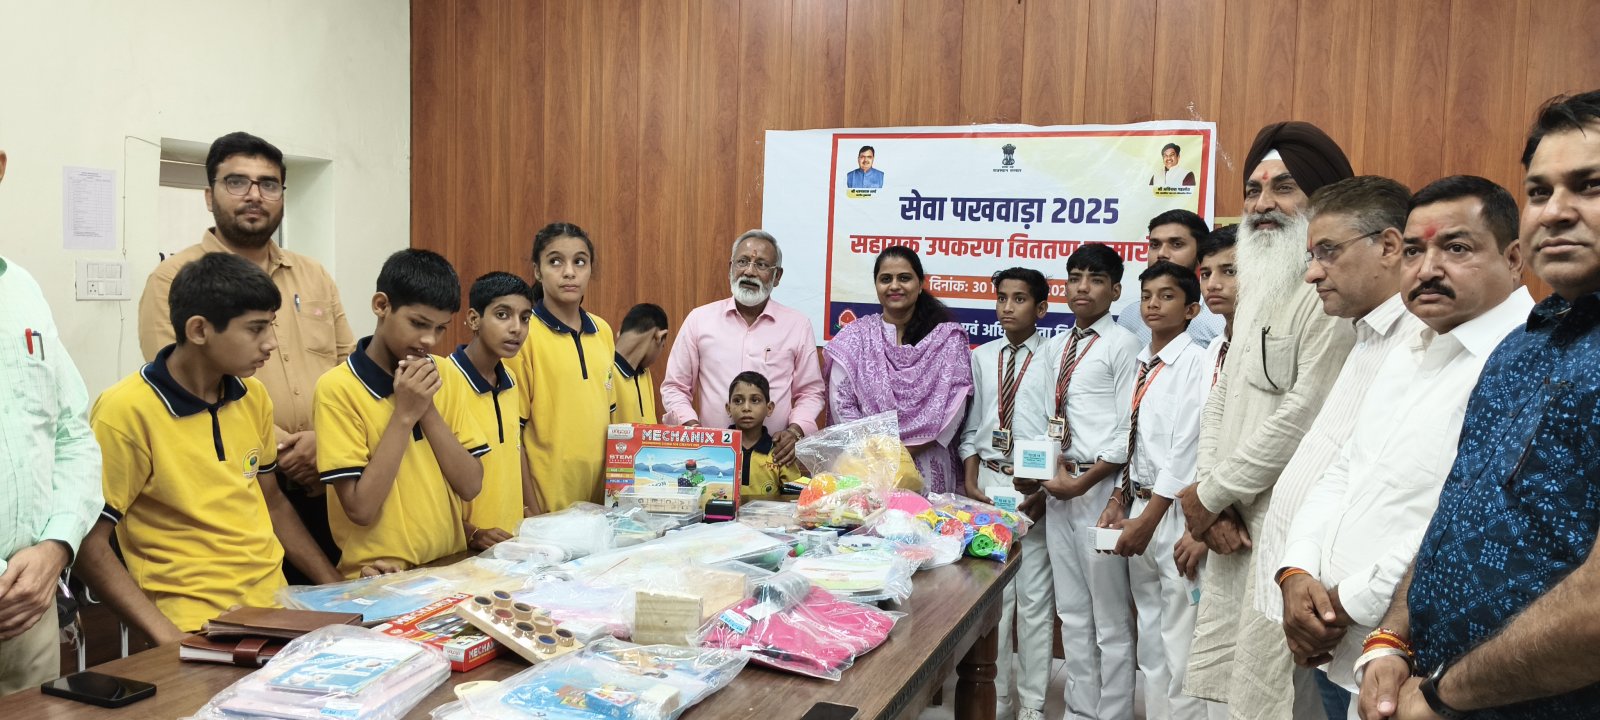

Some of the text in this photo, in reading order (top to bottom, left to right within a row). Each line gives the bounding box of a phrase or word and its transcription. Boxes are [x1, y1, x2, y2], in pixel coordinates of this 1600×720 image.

[899, 188, 1119, 230] सेवा पखवाड़ा 2025
[925, 236, 1004, 257] उपकरण
[929, 276, 969, 293] दिनांक:
[972, 281, 988, 293] 30
[641, 429, 715, 443] MECHANIX
[723, 433, 731, 443] 2
